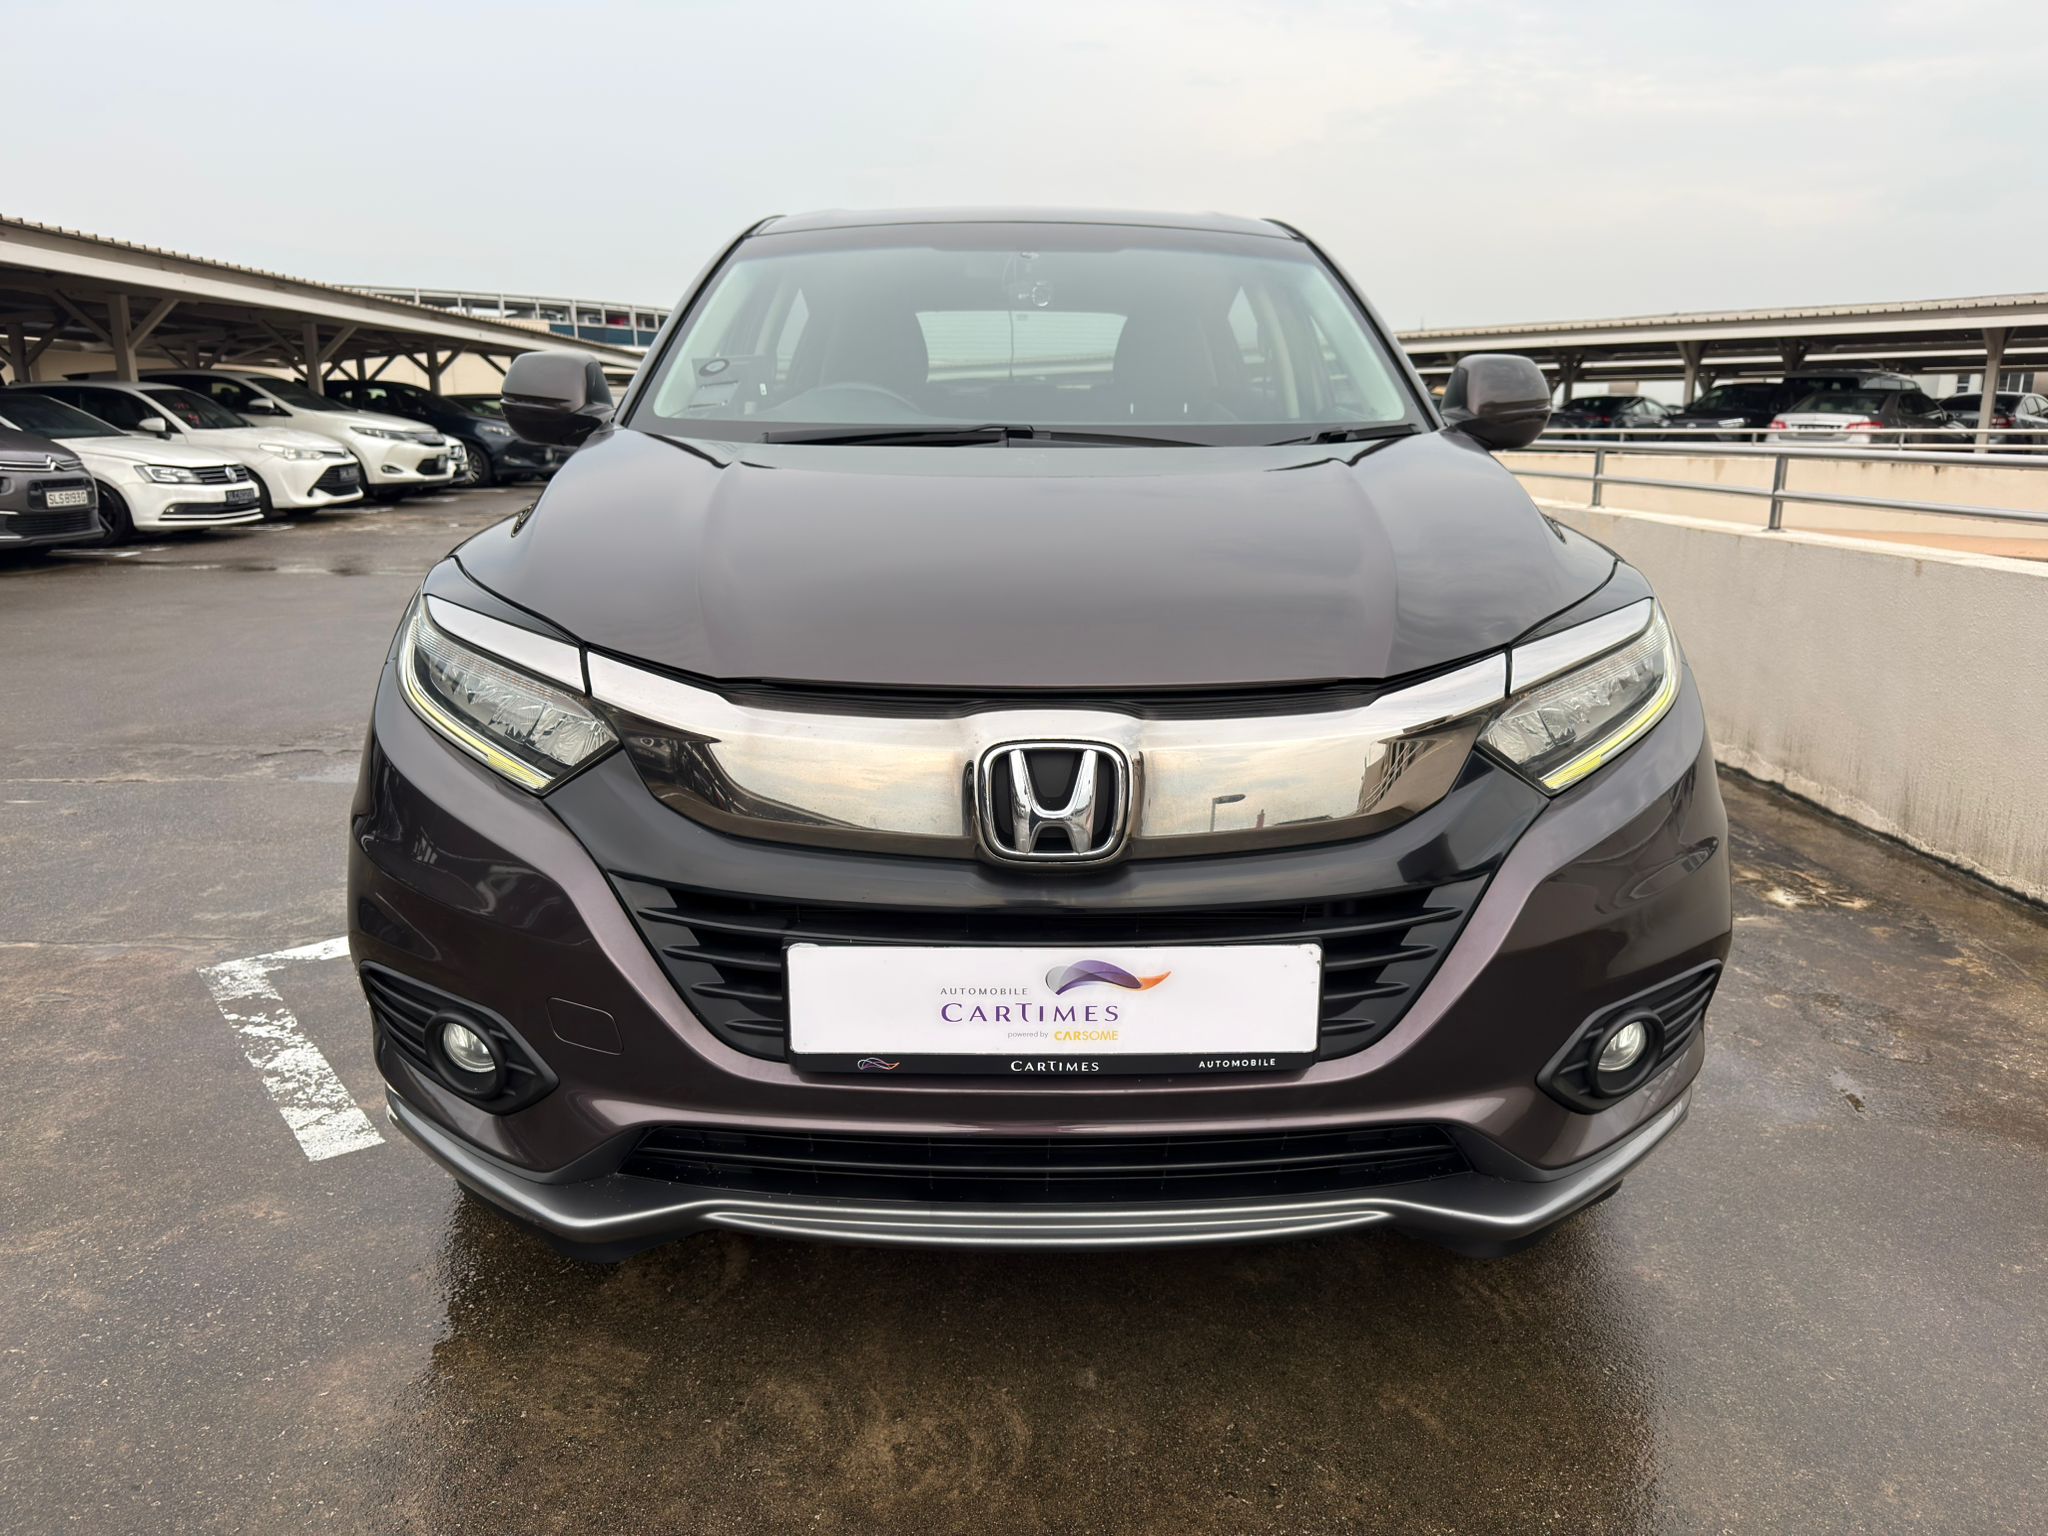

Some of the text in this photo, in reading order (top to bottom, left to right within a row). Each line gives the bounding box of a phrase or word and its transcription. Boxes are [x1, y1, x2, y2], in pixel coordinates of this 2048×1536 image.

[940, 987, 1028, 996] AUTOMOBILE
[1007, 1030, 1119, 1041] powered by CARSOME
[1198, 1057, 1276, 1069] AUTOMOBILE
